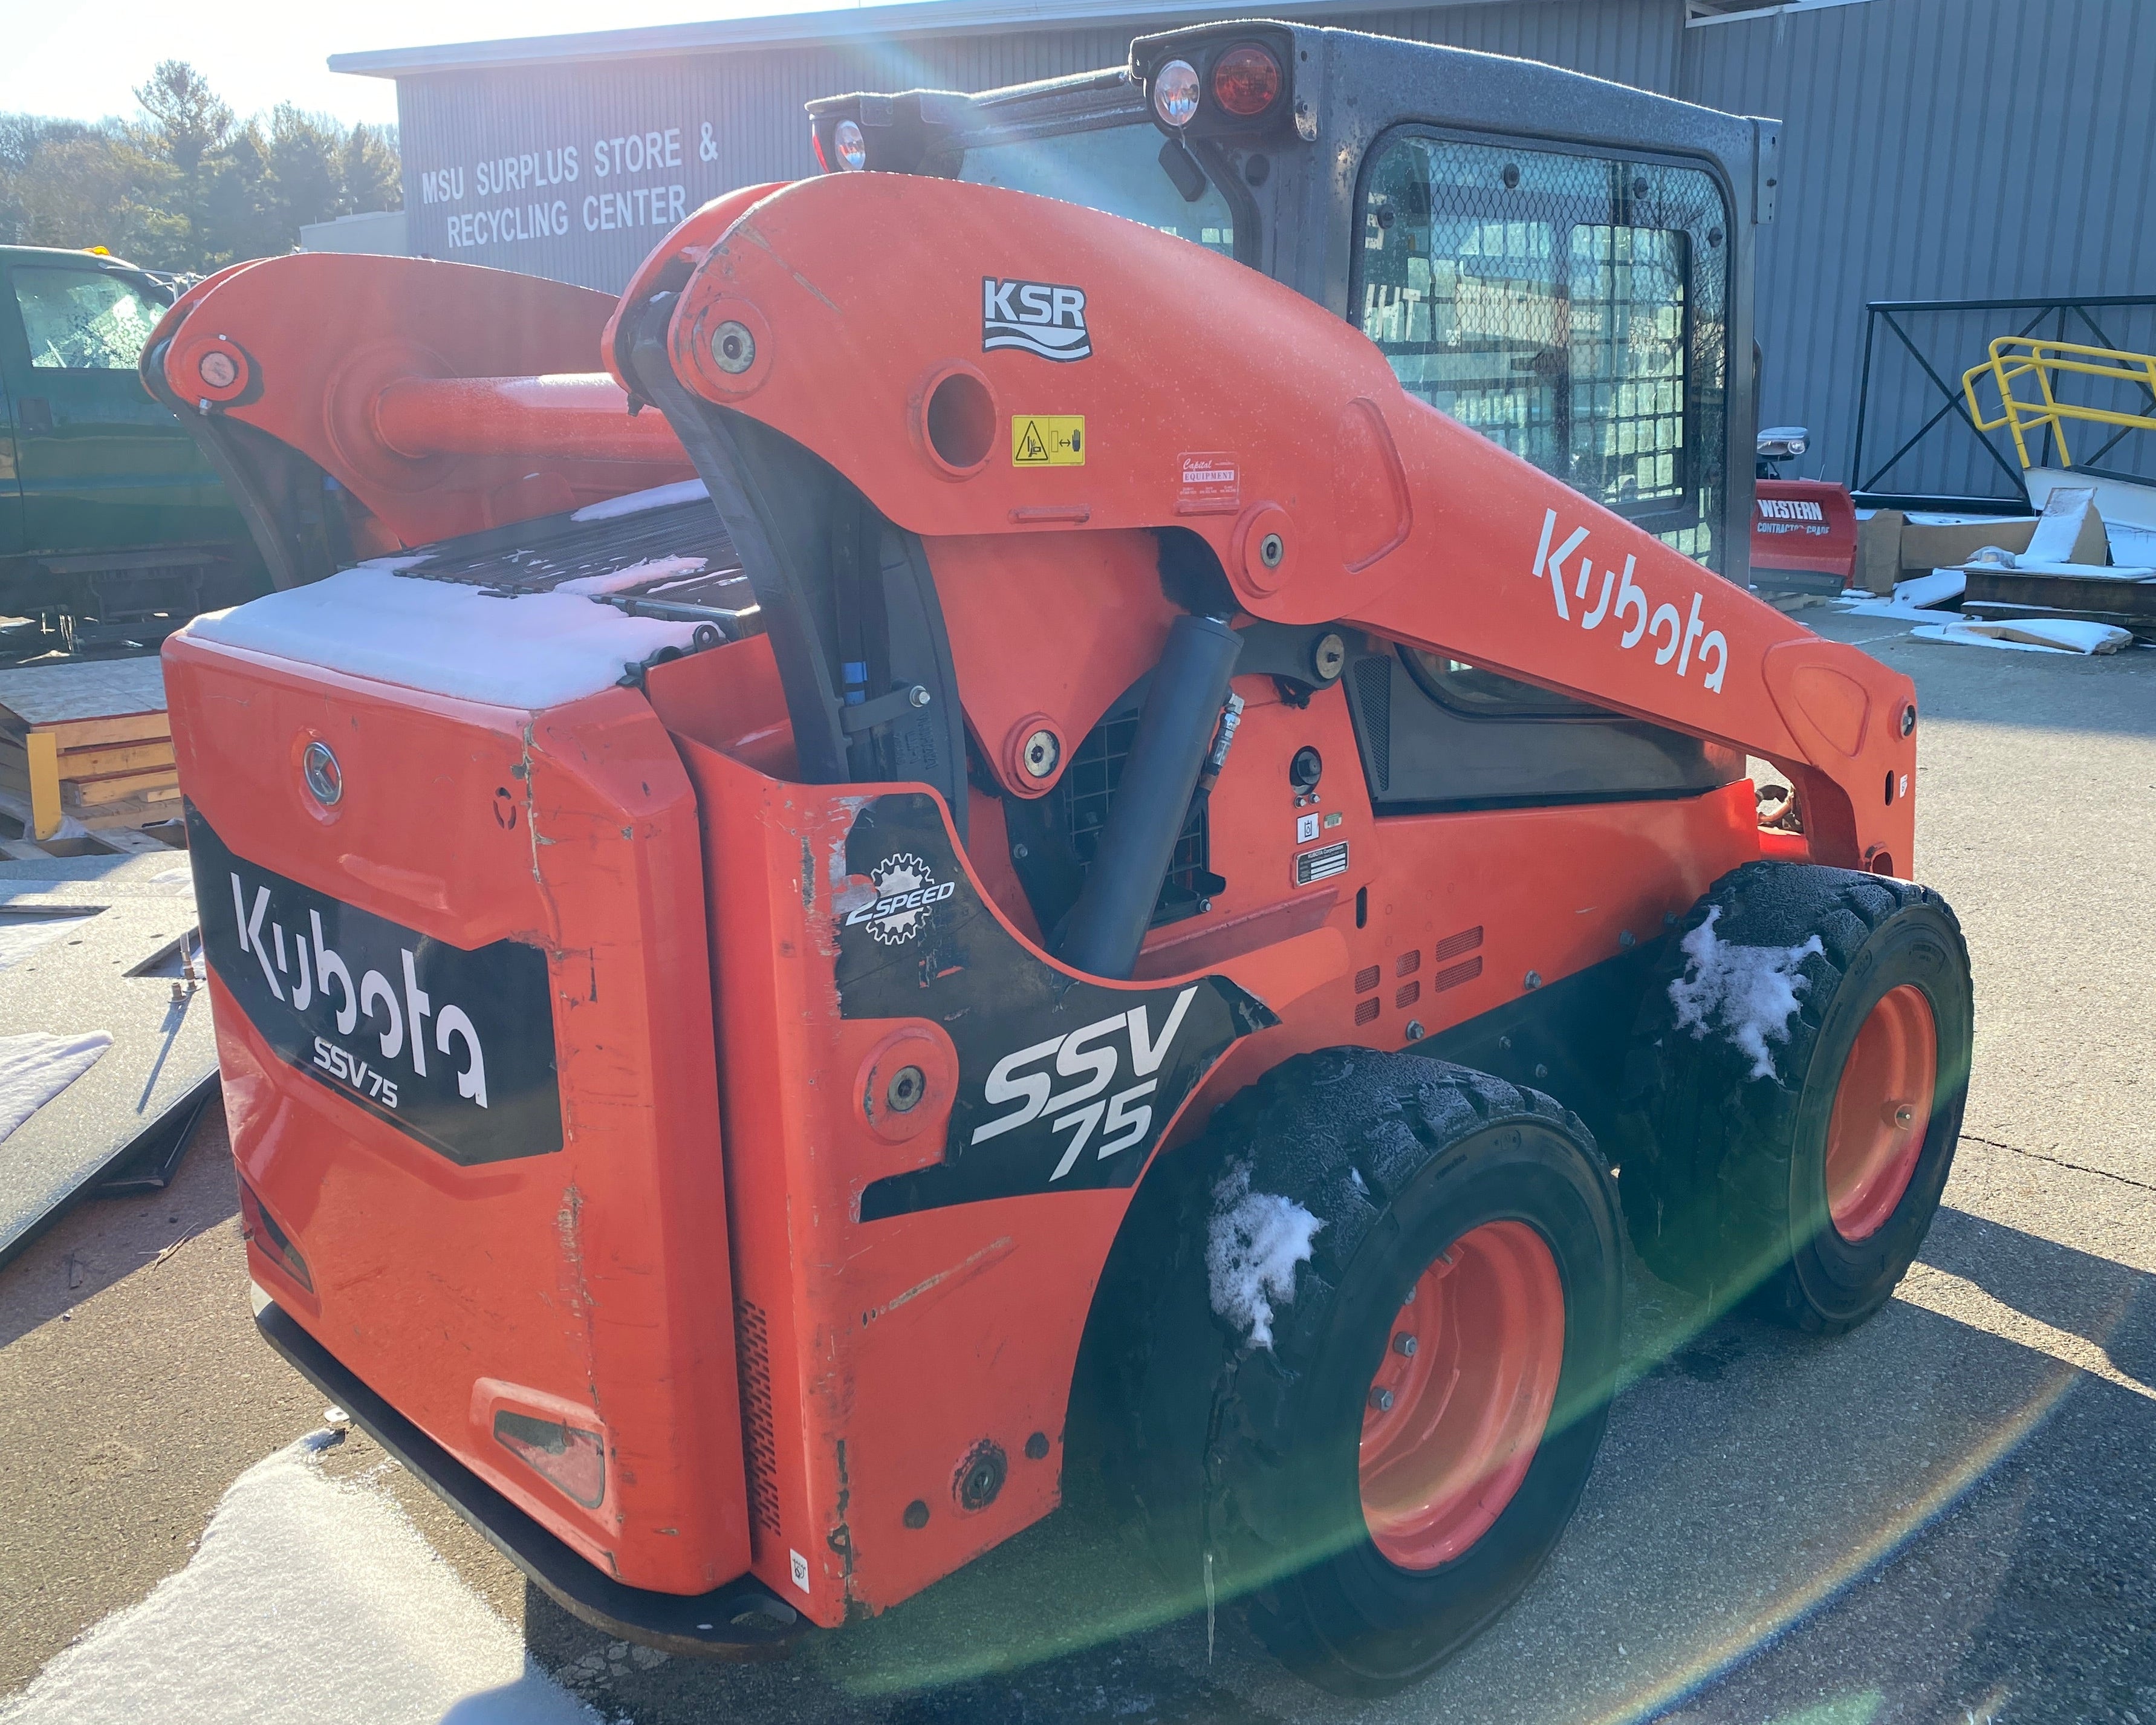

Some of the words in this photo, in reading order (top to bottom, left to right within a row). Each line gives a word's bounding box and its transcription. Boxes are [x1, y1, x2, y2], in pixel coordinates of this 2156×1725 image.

[423, 167, 464, 204] MSU
[476, 146, 579, 197] SURPLUS
[594, 128, 683, 178] STORE
[699, 122, 718, 162] &
[447, 201, 568, 249] RECYCLING
[583, 184, 686, 232] CENTER
[984, 280, 1085, 328] KSR
[1183, 458, 1212, 471] Capital
[1184, 472, 1233, 481] EQUIPMENT
[1757, 499, 1823, 521] WESTERN
[1532, 507, 1729, 694] Kubota
[230, 871, 488, 1109] Kubota
[971, 986, 1199, 1146] SSV
[1049, 1077, 1158, 1183] 75
